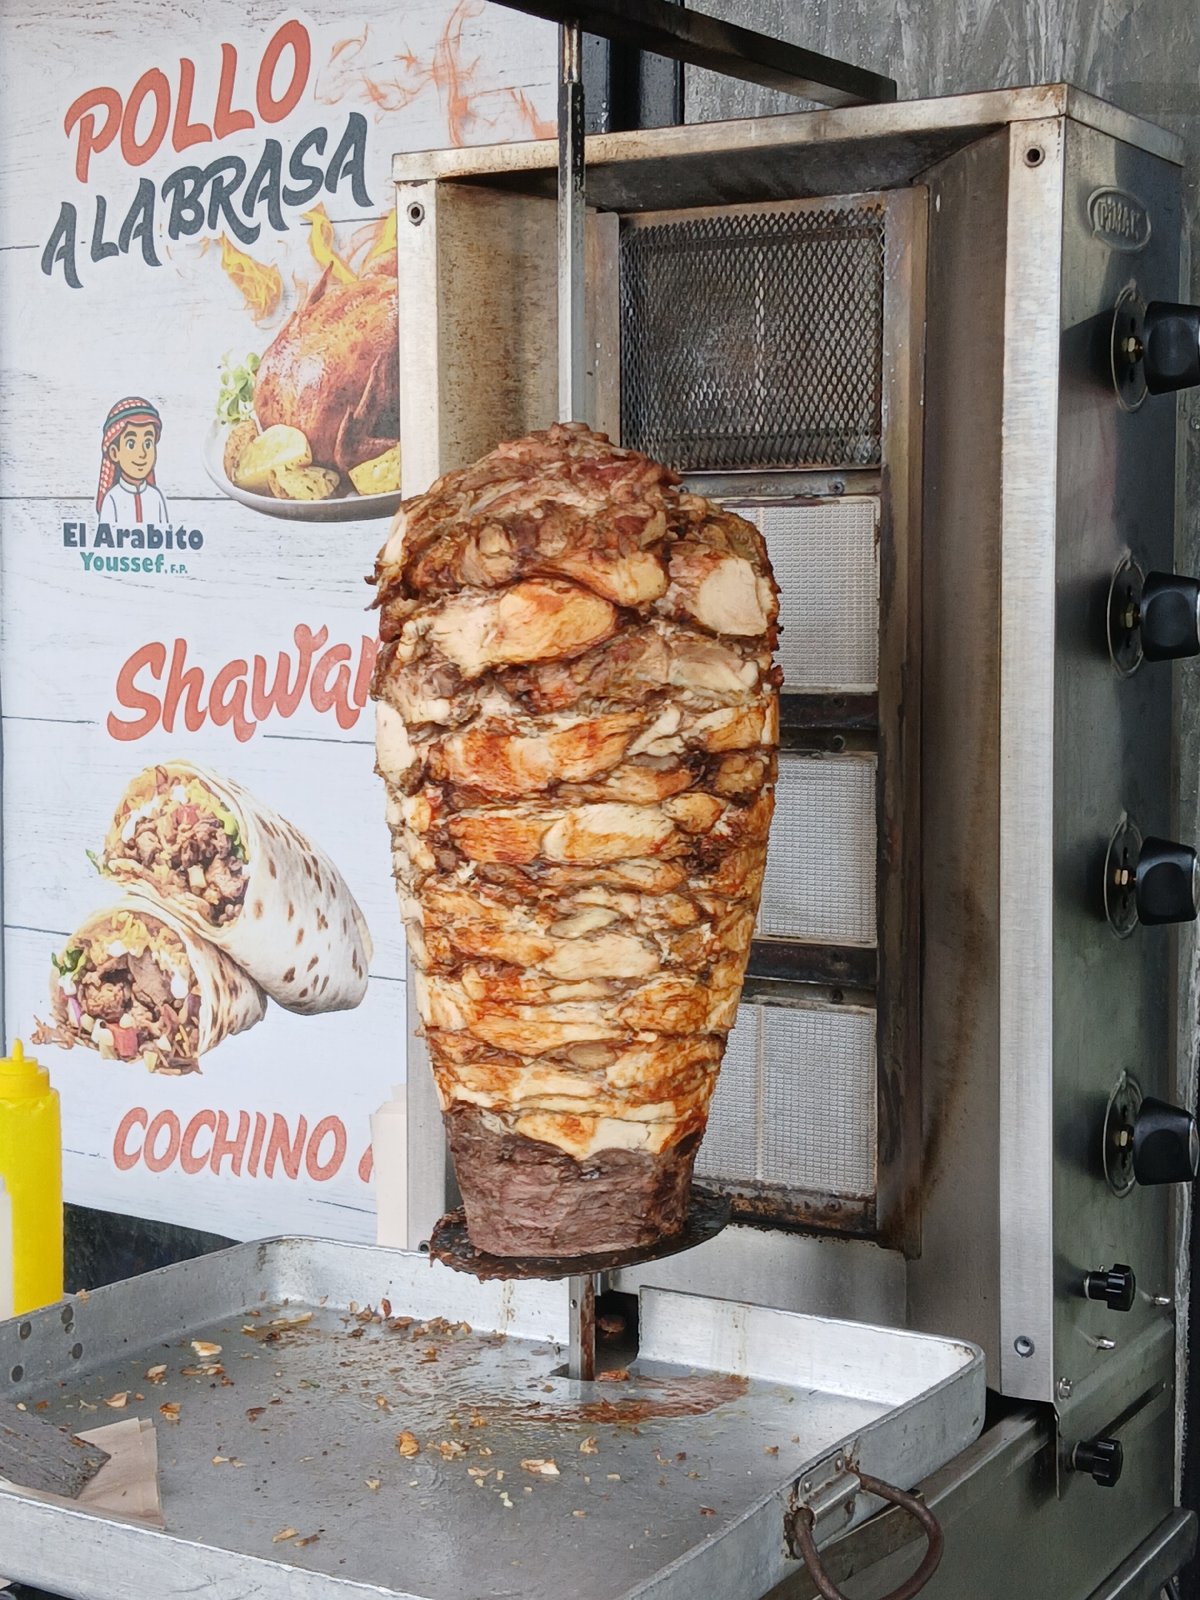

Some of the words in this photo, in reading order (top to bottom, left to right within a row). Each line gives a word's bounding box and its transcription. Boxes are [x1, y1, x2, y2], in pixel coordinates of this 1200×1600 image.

[64, 19, 311, 184] POLLO
[161, 111, 375, 245] BRASA
[63, 522, 87, 548] El
[93, 523, 204, 551] Arabito
[112, 1106, 348, 1182] COCHINO
